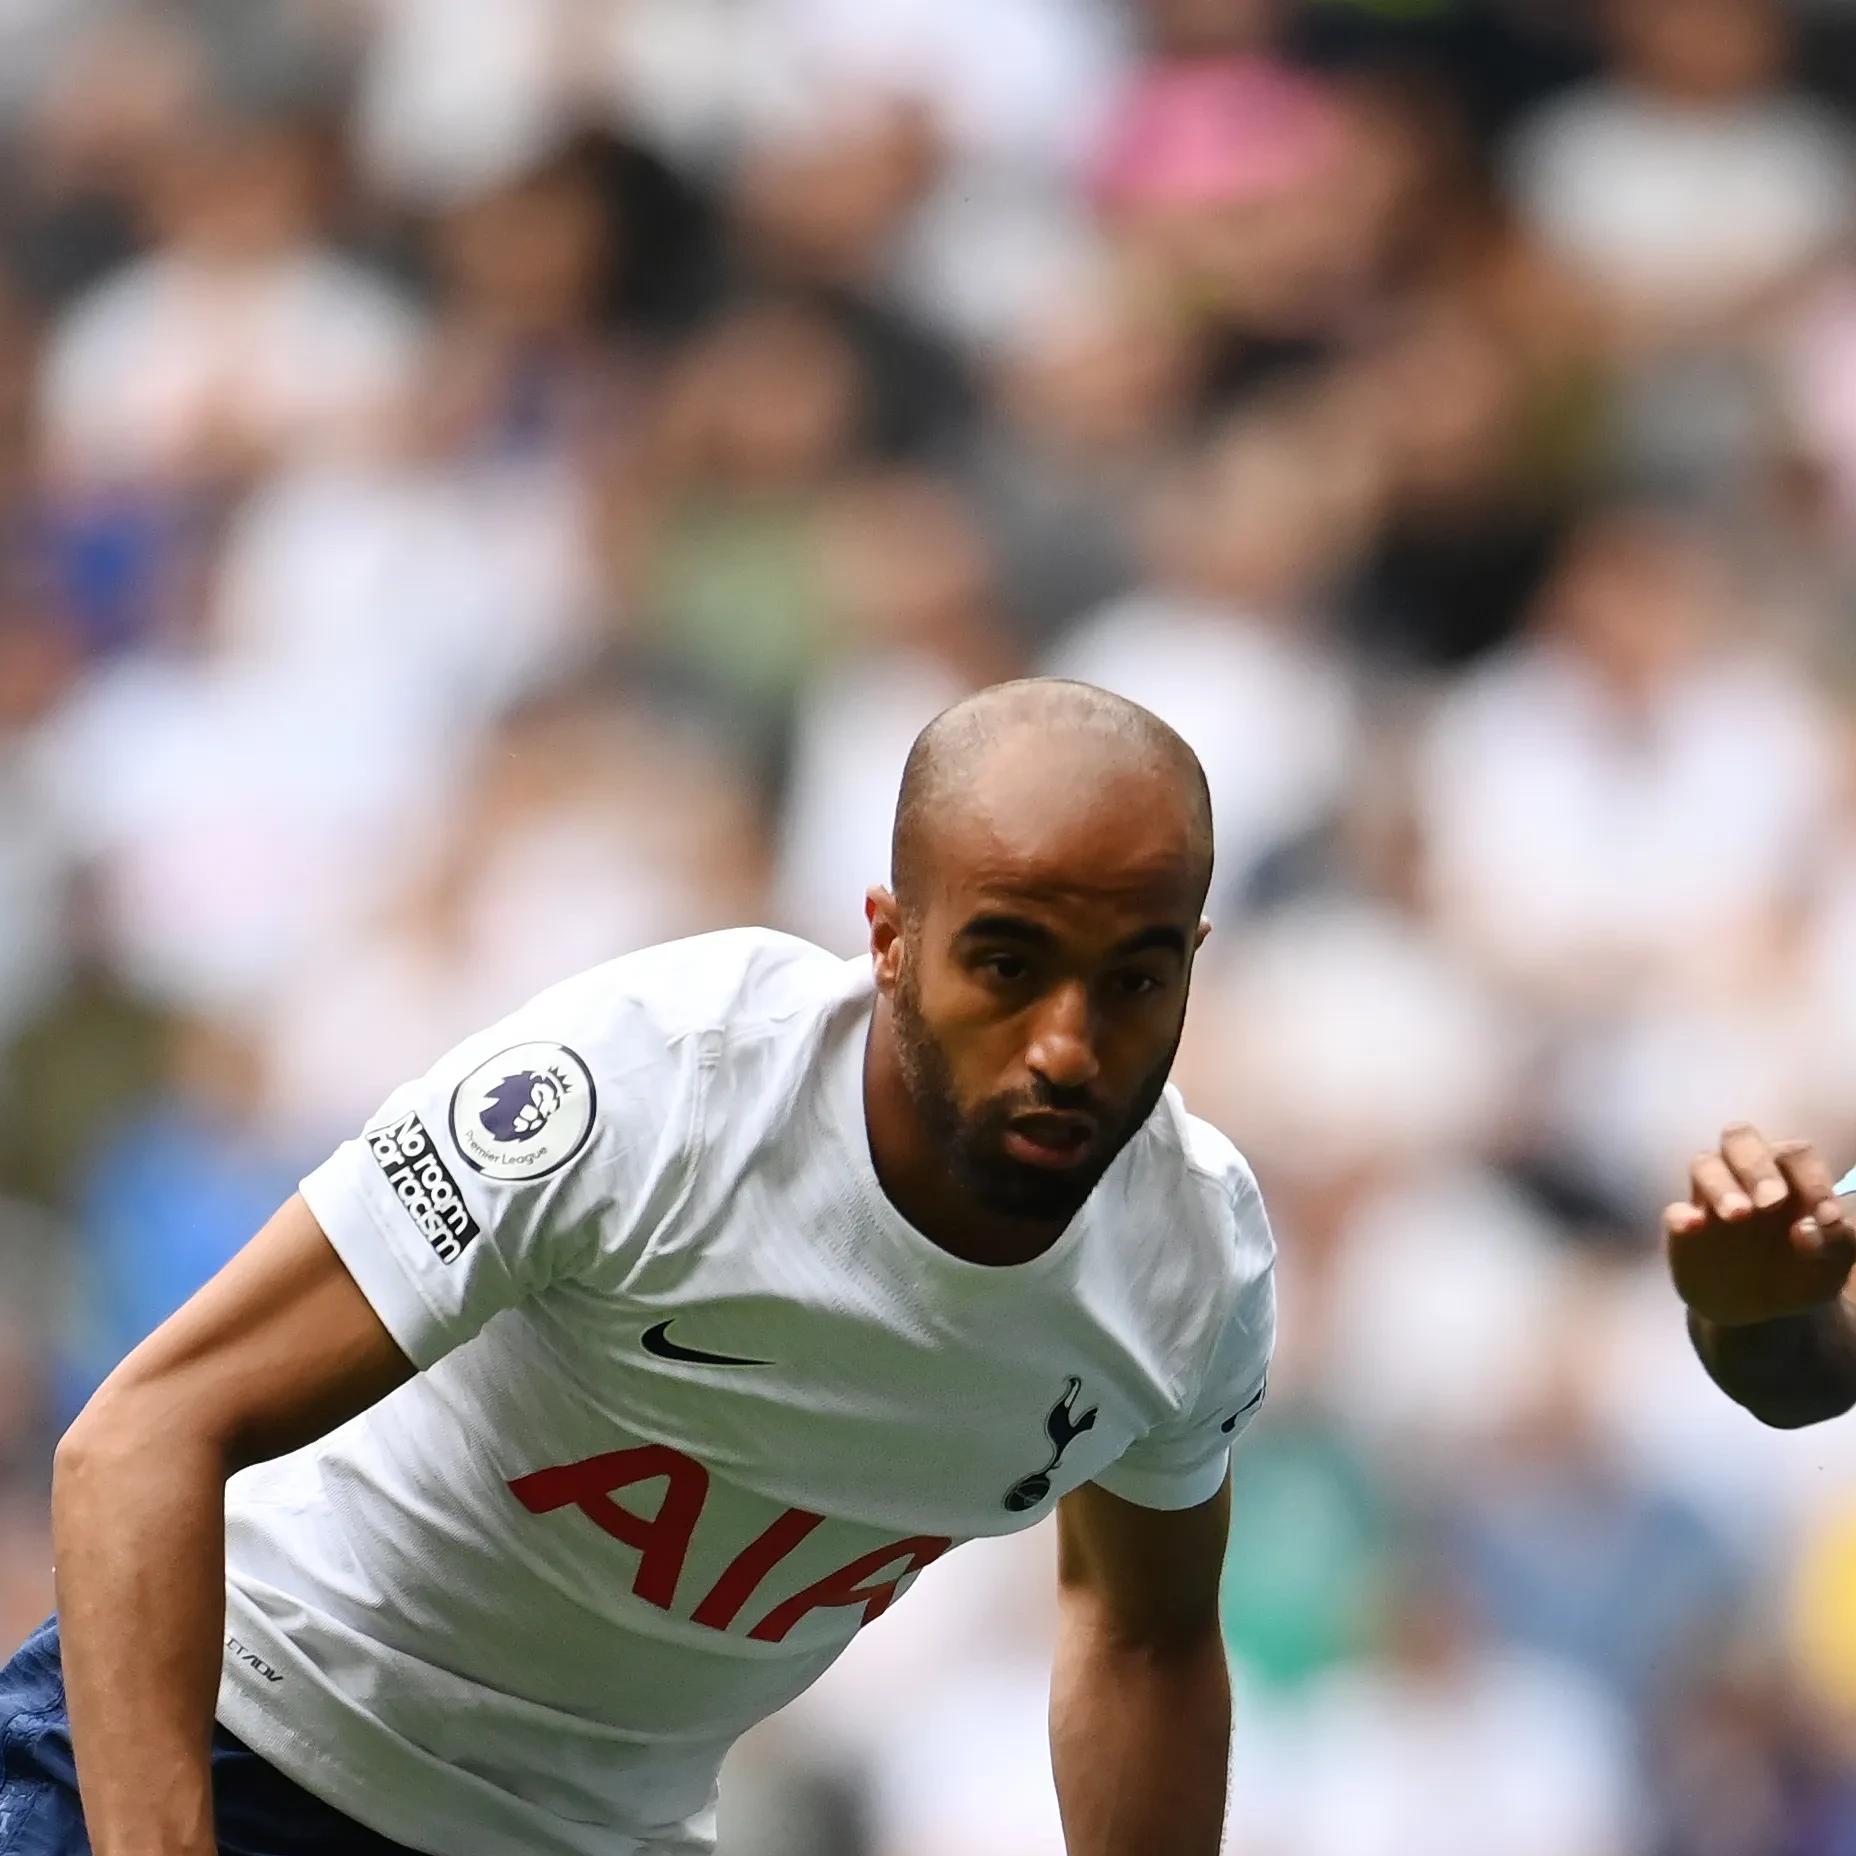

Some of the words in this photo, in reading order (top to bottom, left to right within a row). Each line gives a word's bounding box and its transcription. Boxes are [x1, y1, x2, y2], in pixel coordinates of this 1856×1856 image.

[390, 1111, 427, 1157] No
[413, 1153, 470, 1235] room
[465, 1130, 500, 1164] Premier
[501, 1146, 548, 1166] League
[390, 1166, 463, 1264] racism
[507, 1443, 953, 1644] AIA
